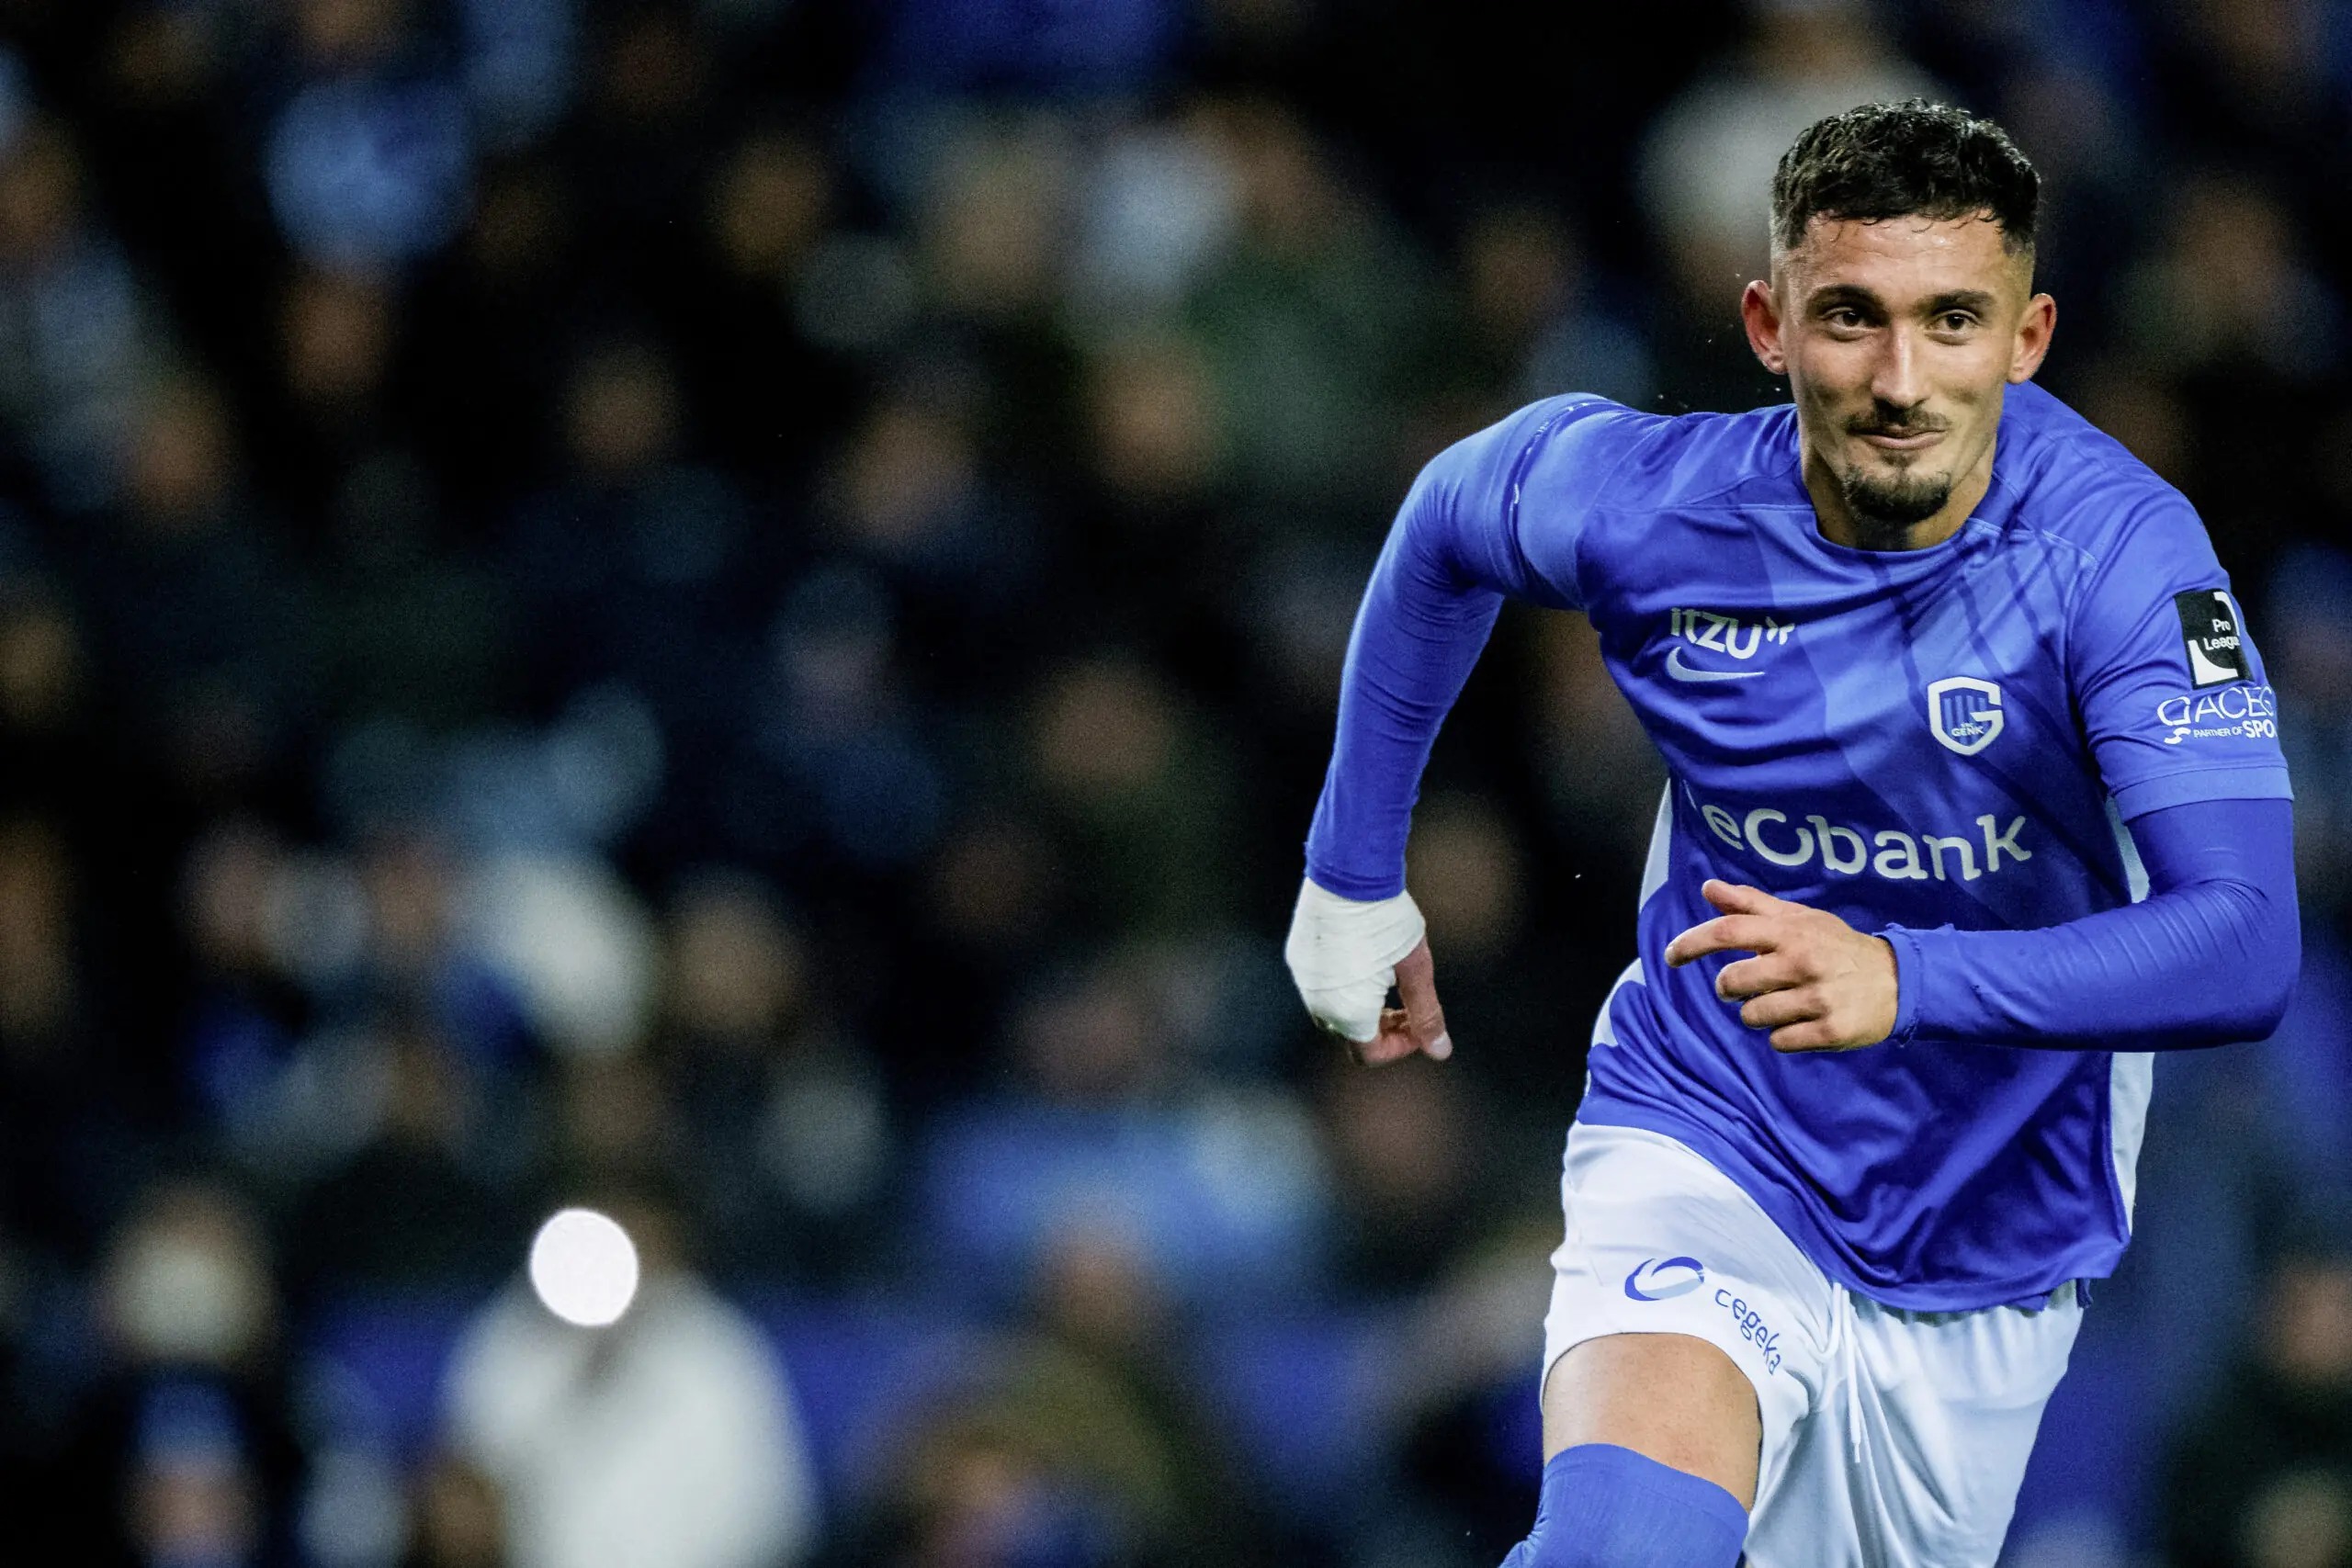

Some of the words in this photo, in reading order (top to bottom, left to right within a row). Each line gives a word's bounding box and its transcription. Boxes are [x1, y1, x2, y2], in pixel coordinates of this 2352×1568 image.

[2212, 619, 2231, 632] Pro
[1951, 726, 1984, 737] GENK
[2242, 719, 2278, 739] SPO
[1714, 1288, 1781, 1375] cegeka
